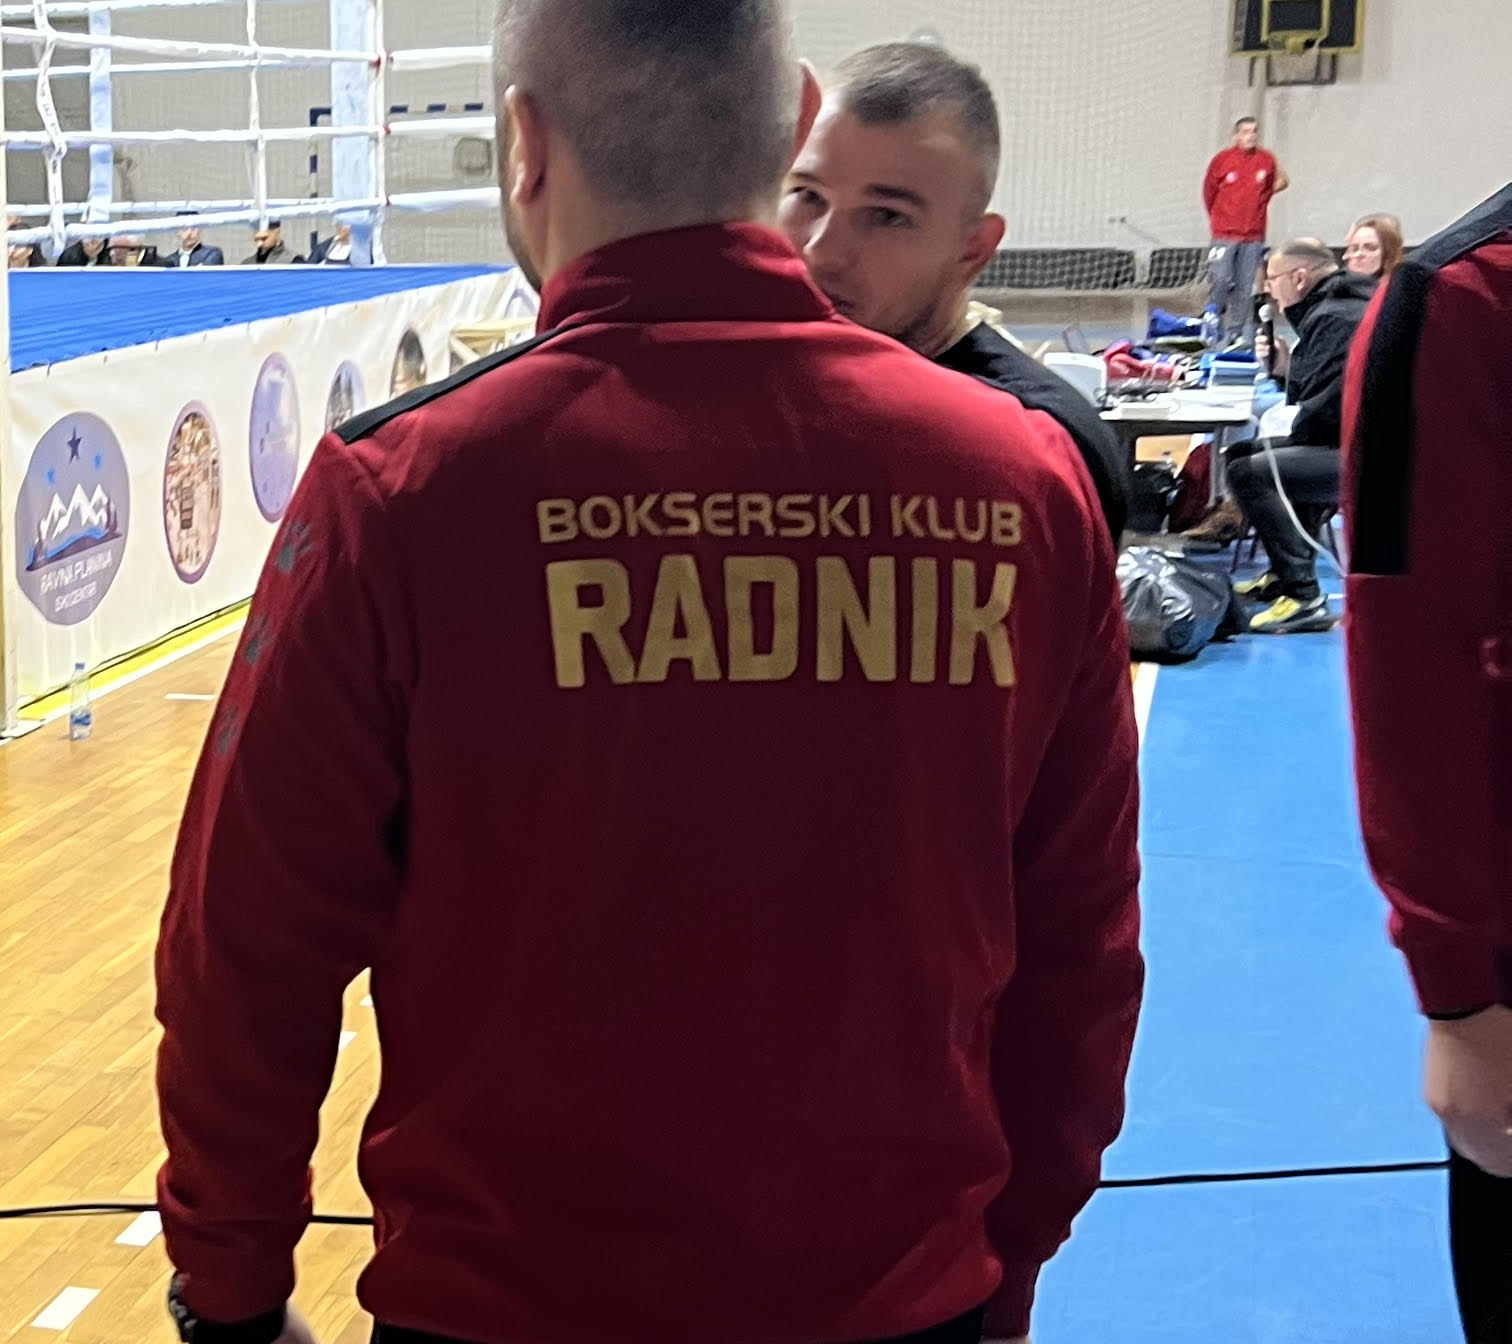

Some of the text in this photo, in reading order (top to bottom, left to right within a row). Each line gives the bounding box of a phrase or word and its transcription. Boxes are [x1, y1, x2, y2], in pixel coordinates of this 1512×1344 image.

[537, 492, 1024, 547] BOKSERSKI KLUB
[544, 554, 1018, 689] RADNIK
